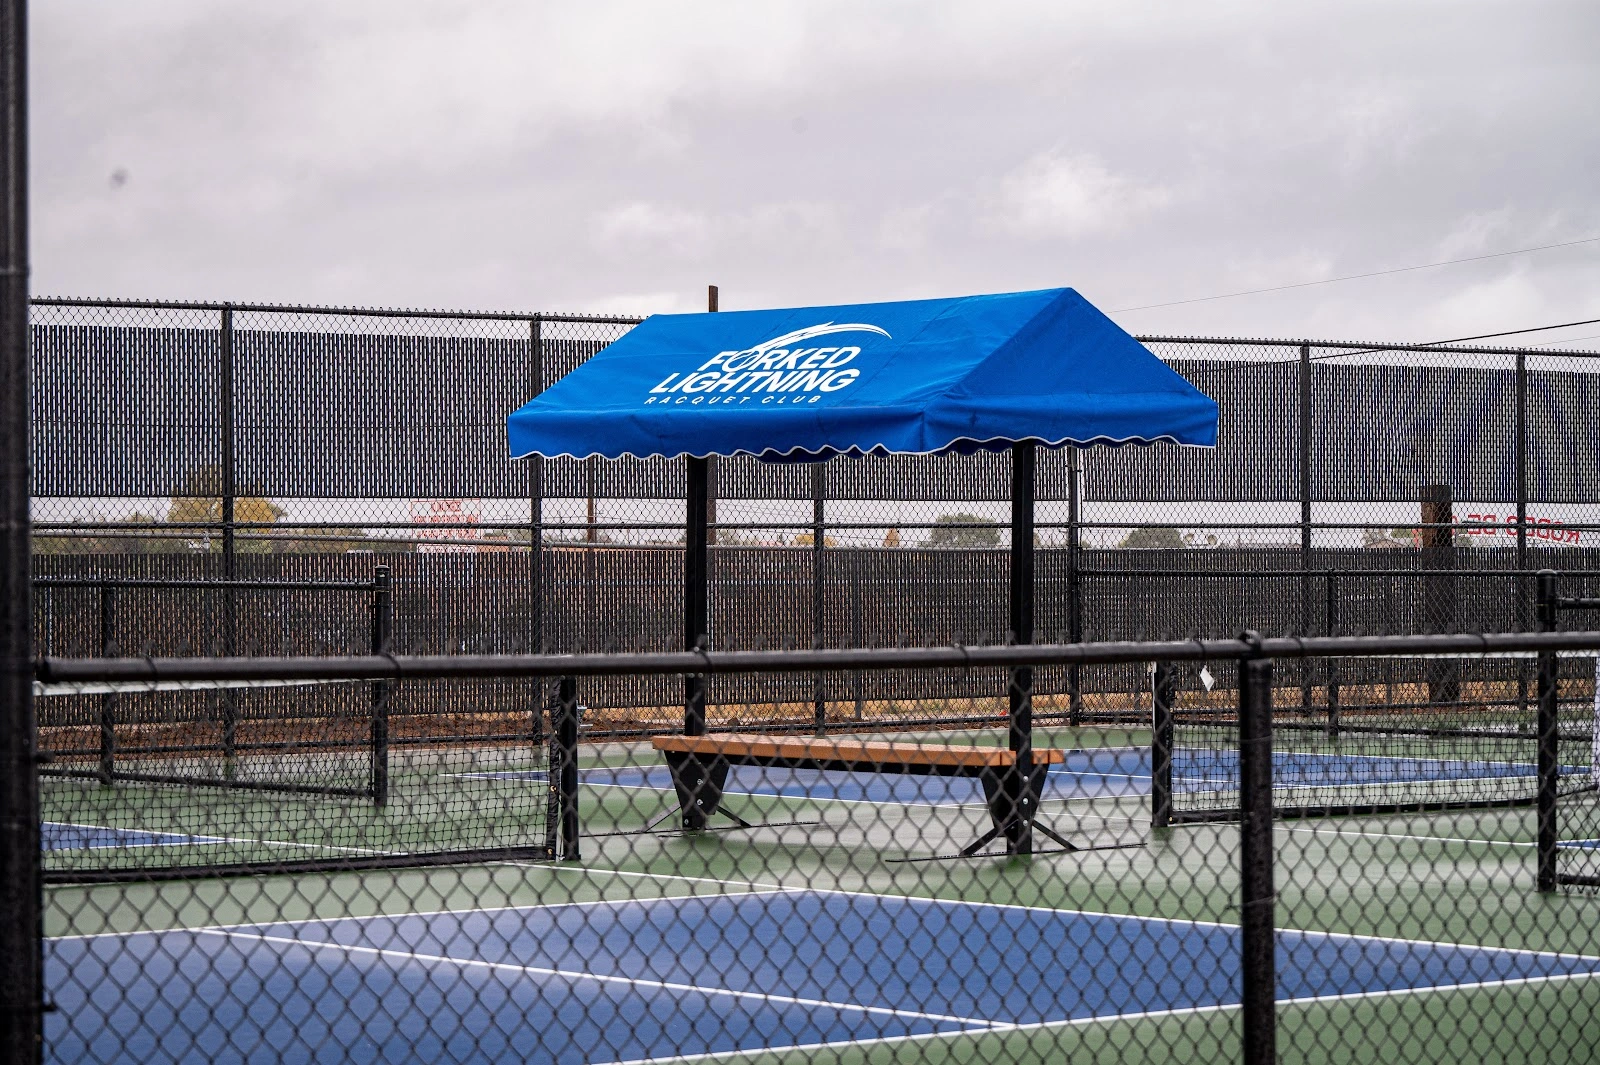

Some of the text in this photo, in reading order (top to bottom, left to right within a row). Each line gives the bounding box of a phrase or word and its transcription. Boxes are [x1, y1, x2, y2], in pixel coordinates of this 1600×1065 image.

[697, 346, 862, 373] FORKED
[649, 368, 861, 394] LIGHTNING
[644, 394, 822, 406] RACQUET CLUB
